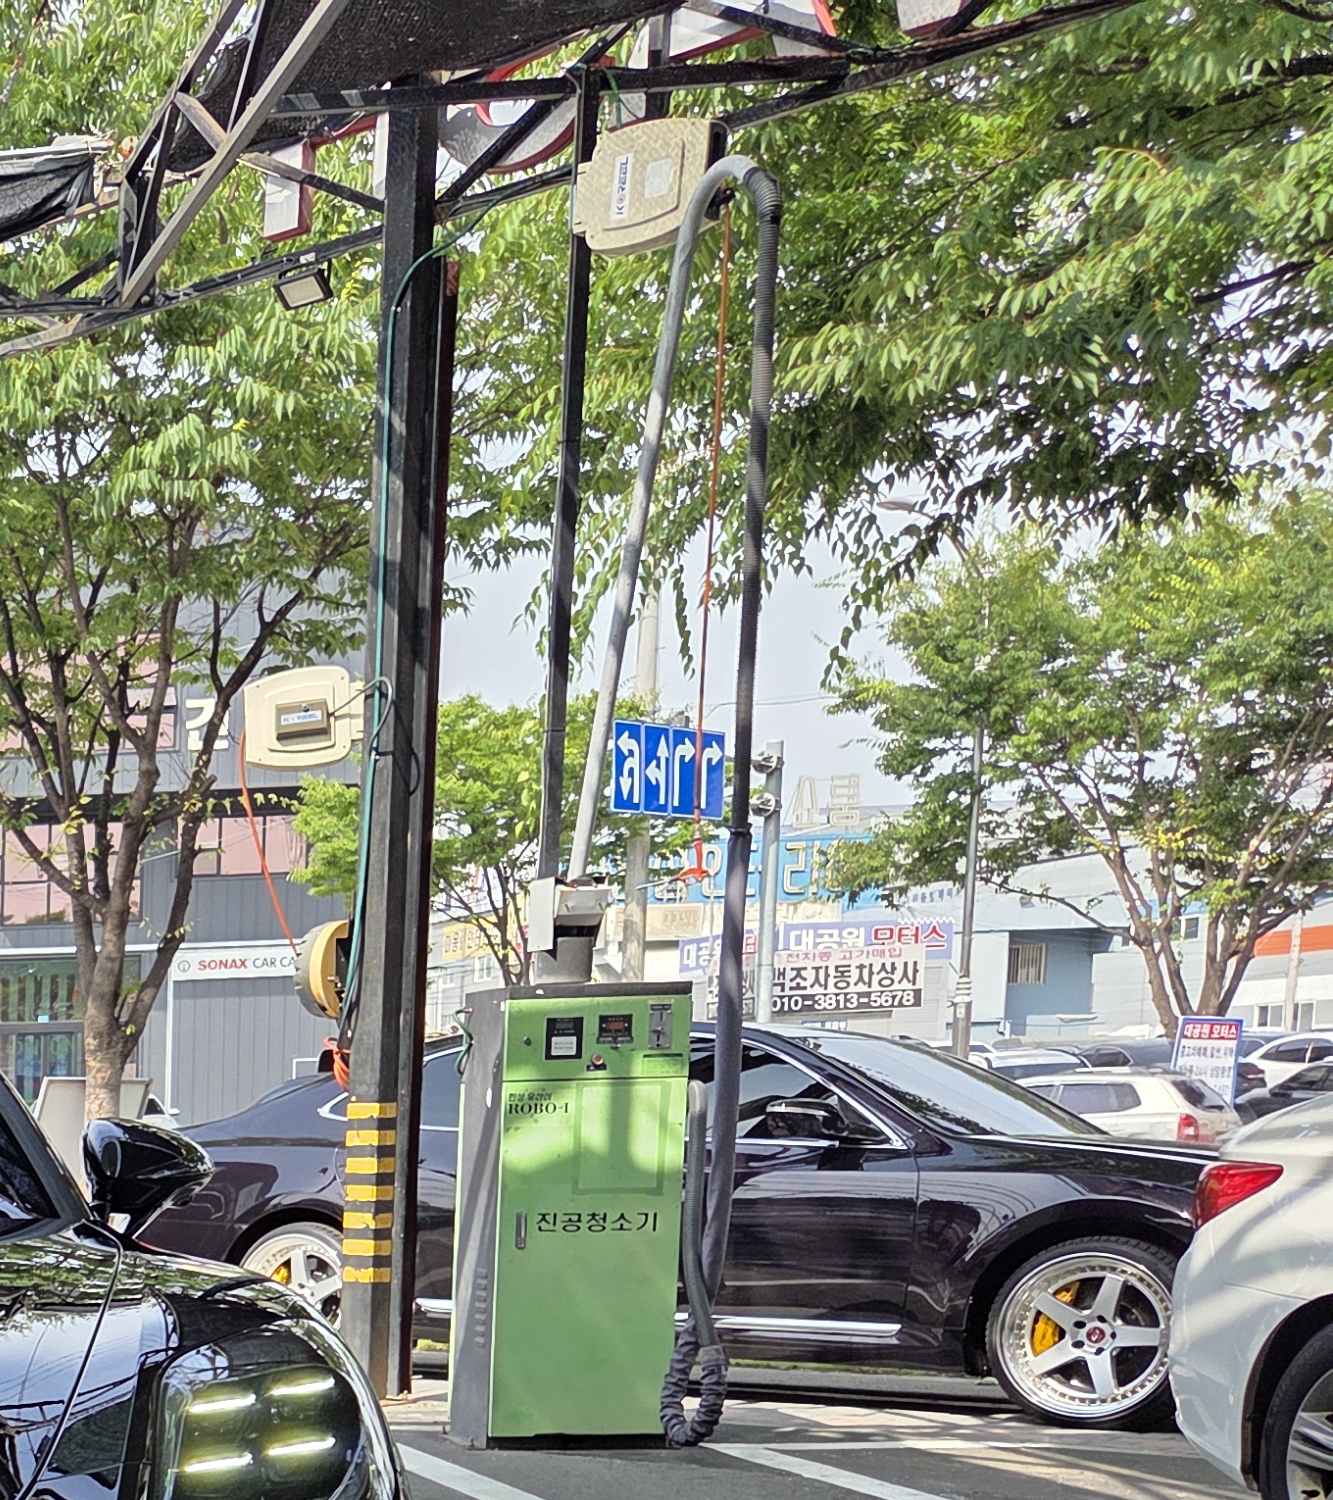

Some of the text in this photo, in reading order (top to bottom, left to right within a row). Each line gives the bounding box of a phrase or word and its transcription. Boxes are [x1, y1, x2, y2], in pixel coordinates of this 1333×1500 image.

[789, 925, 947, 950] 대공원 모터스
[198, 956, 297, 971] SONAX CAR CA
[839, 947, 902, 961] 고가매입
[772, 990, 915, 1012] 010-3813-5678
[536, 1212, 658, 1234] 진공청소기
